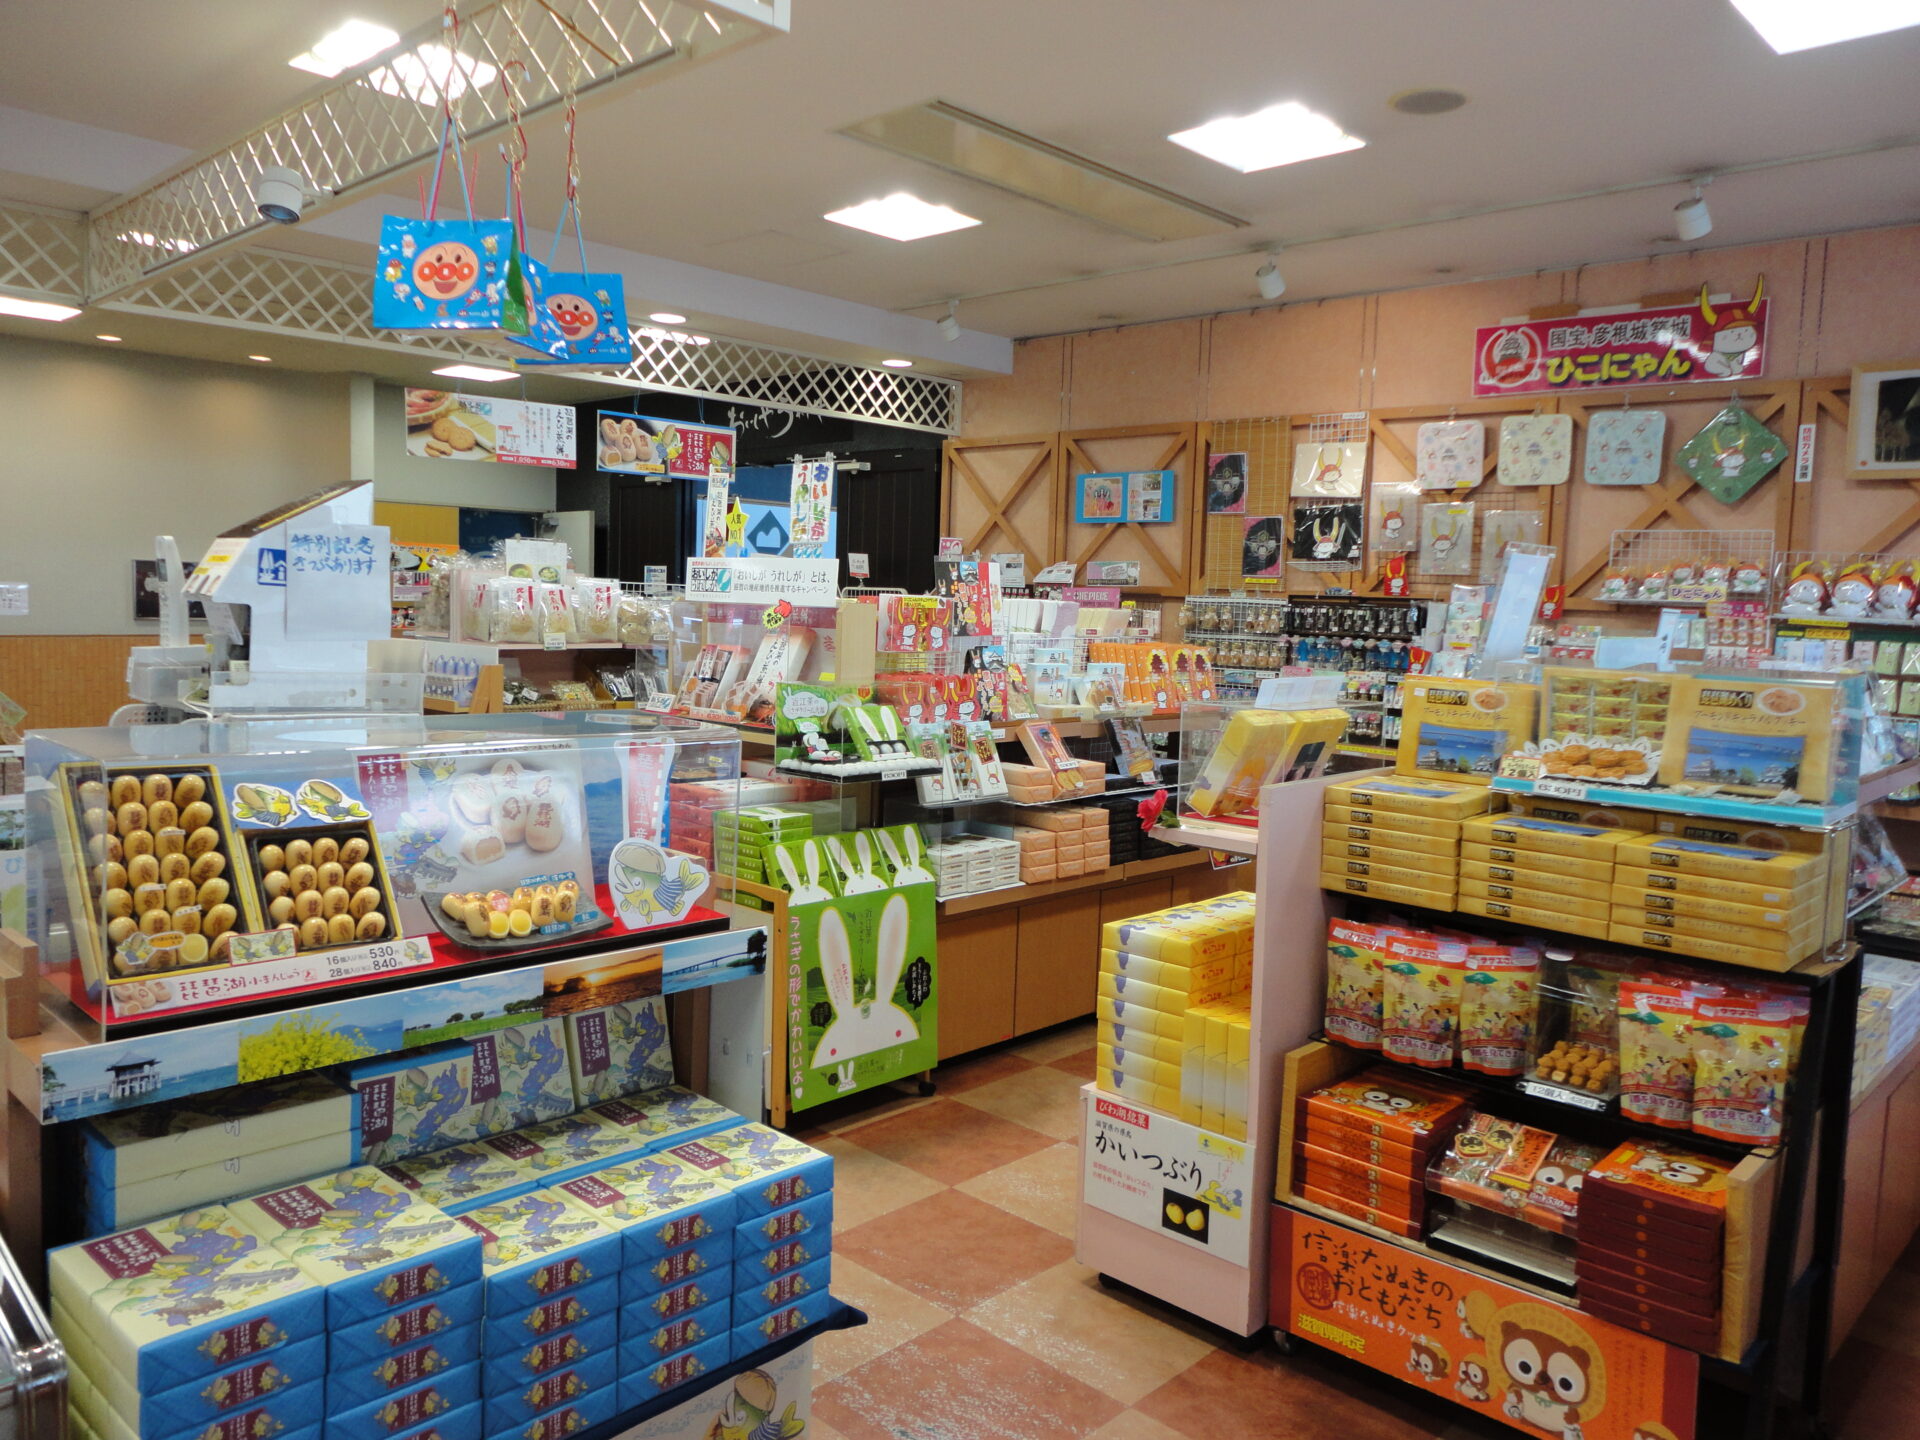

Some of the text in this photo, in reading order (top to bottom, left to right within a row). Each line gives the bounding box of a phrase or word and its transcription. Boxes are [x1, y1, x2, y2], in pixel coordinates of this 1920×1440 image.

[1546, 350, 1691, 384] ひこにゃん
[731, 513, 741, 524] 人気
[1099, 1102, 1147, 1127] びわ湖銘菓
[1095, 1130, 1202, 1192] かいつぶり
[1302, 1229, 1454, 1302] 信楽たぬきの
[1333, 1268, 1443, 1329] おともだち
[1298, 1313, 1366, 1354] 滋賀県限定
[1332, 1300, 1442, 1348] 信楽たぬきクッキー
